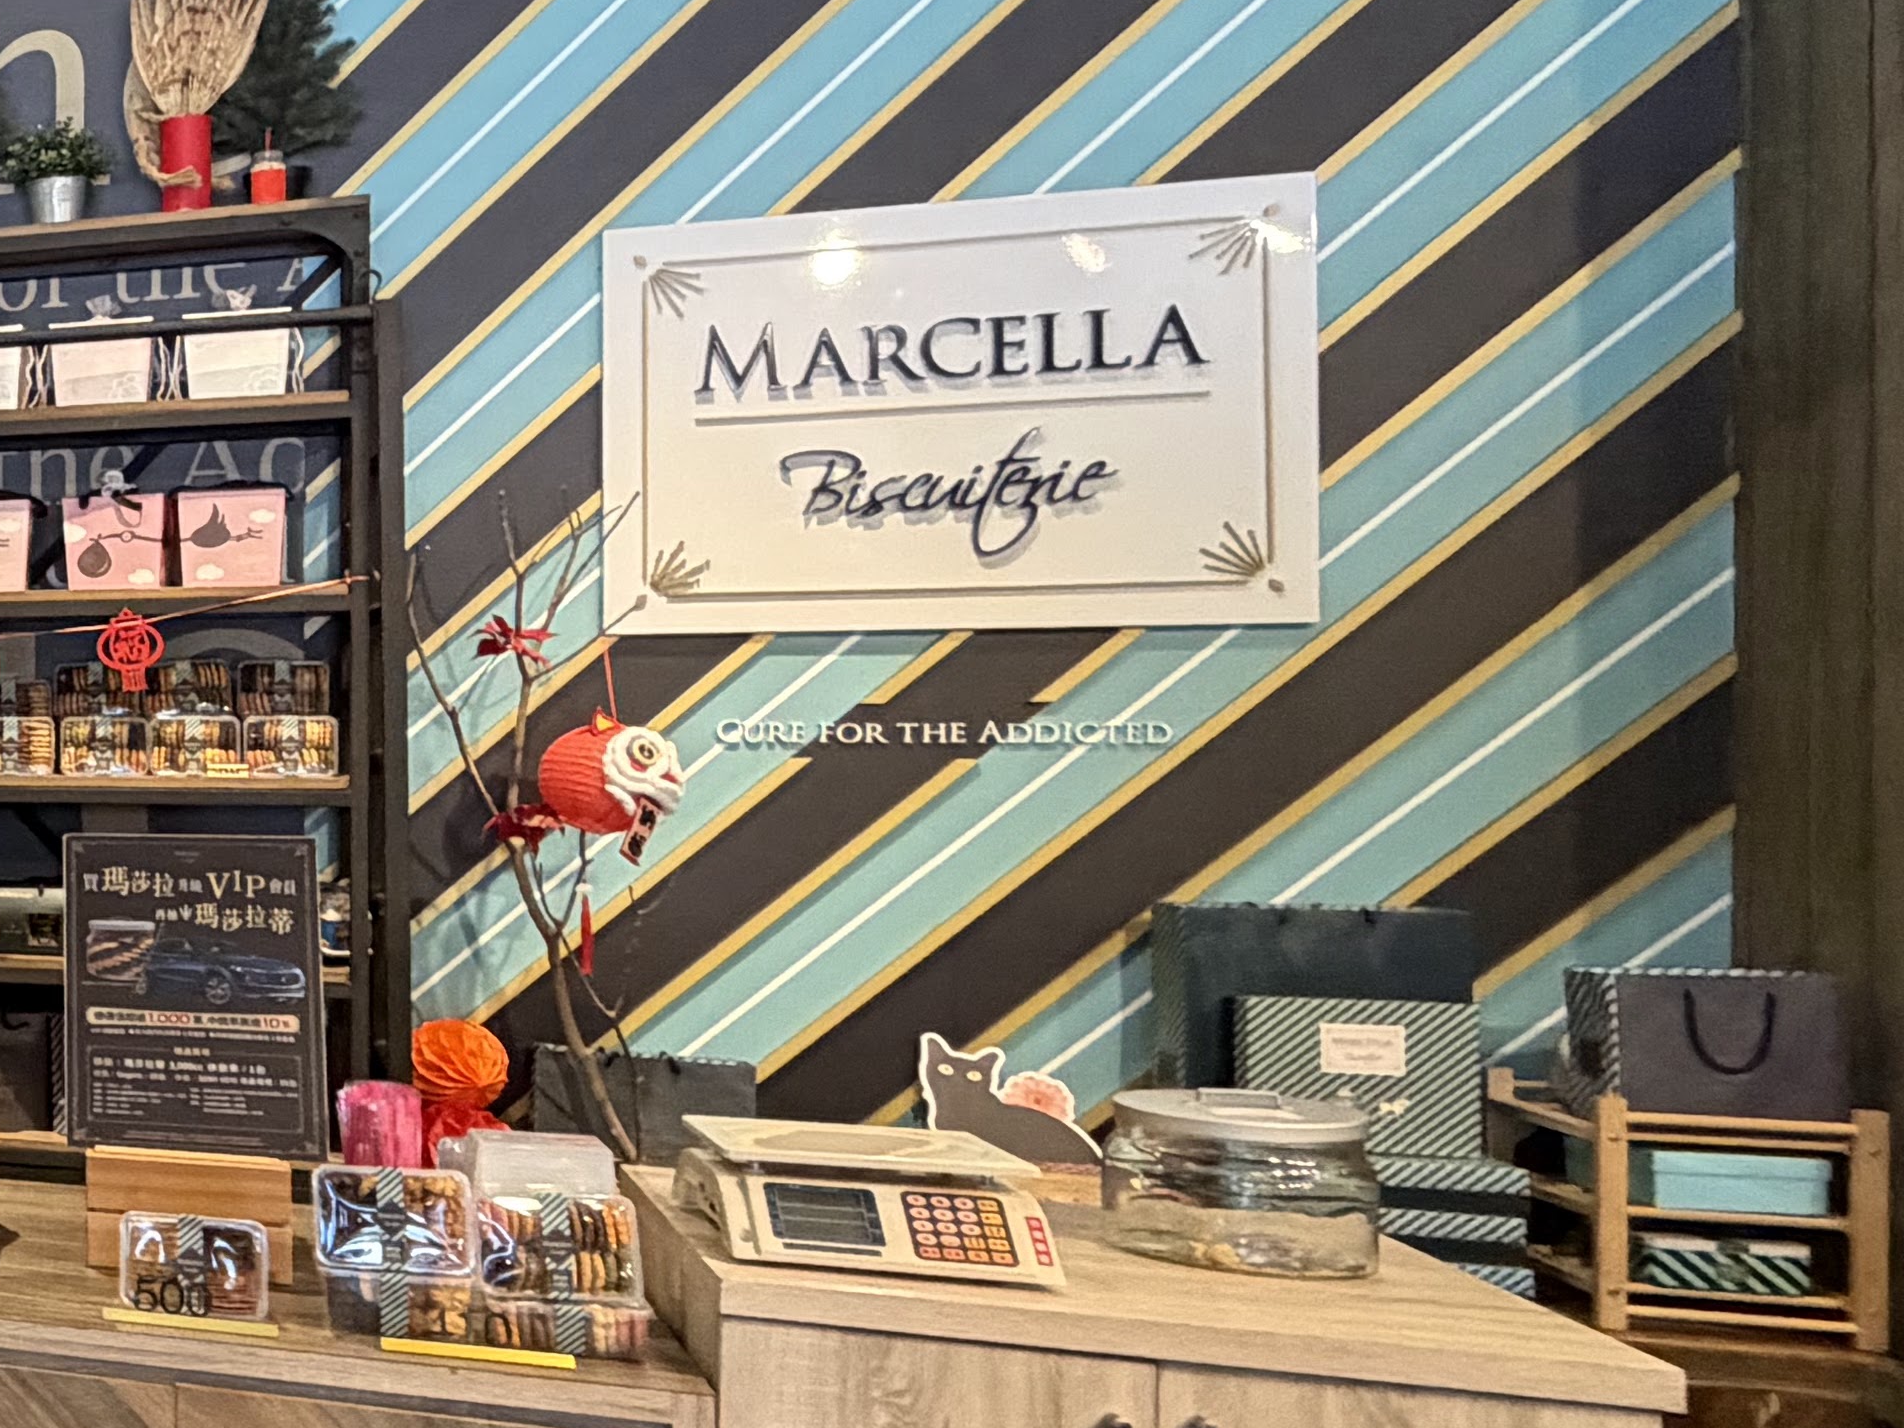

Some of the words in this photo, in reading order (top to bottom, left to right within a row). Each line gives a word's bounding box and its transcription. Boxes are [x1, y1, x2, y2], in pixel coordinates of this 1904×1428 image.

[694, 304, 1211, 401] MARCELLA
[780, 426, 1118, 560] Biscuiterie
[716, 722, 805, 745] CURE
[820, 722, 888, 745] FOR
[897, 722, 966, 744] THE
[970, 719, 1174, 745] ADDICTED
[134, 1274, 208, 1317] 500
